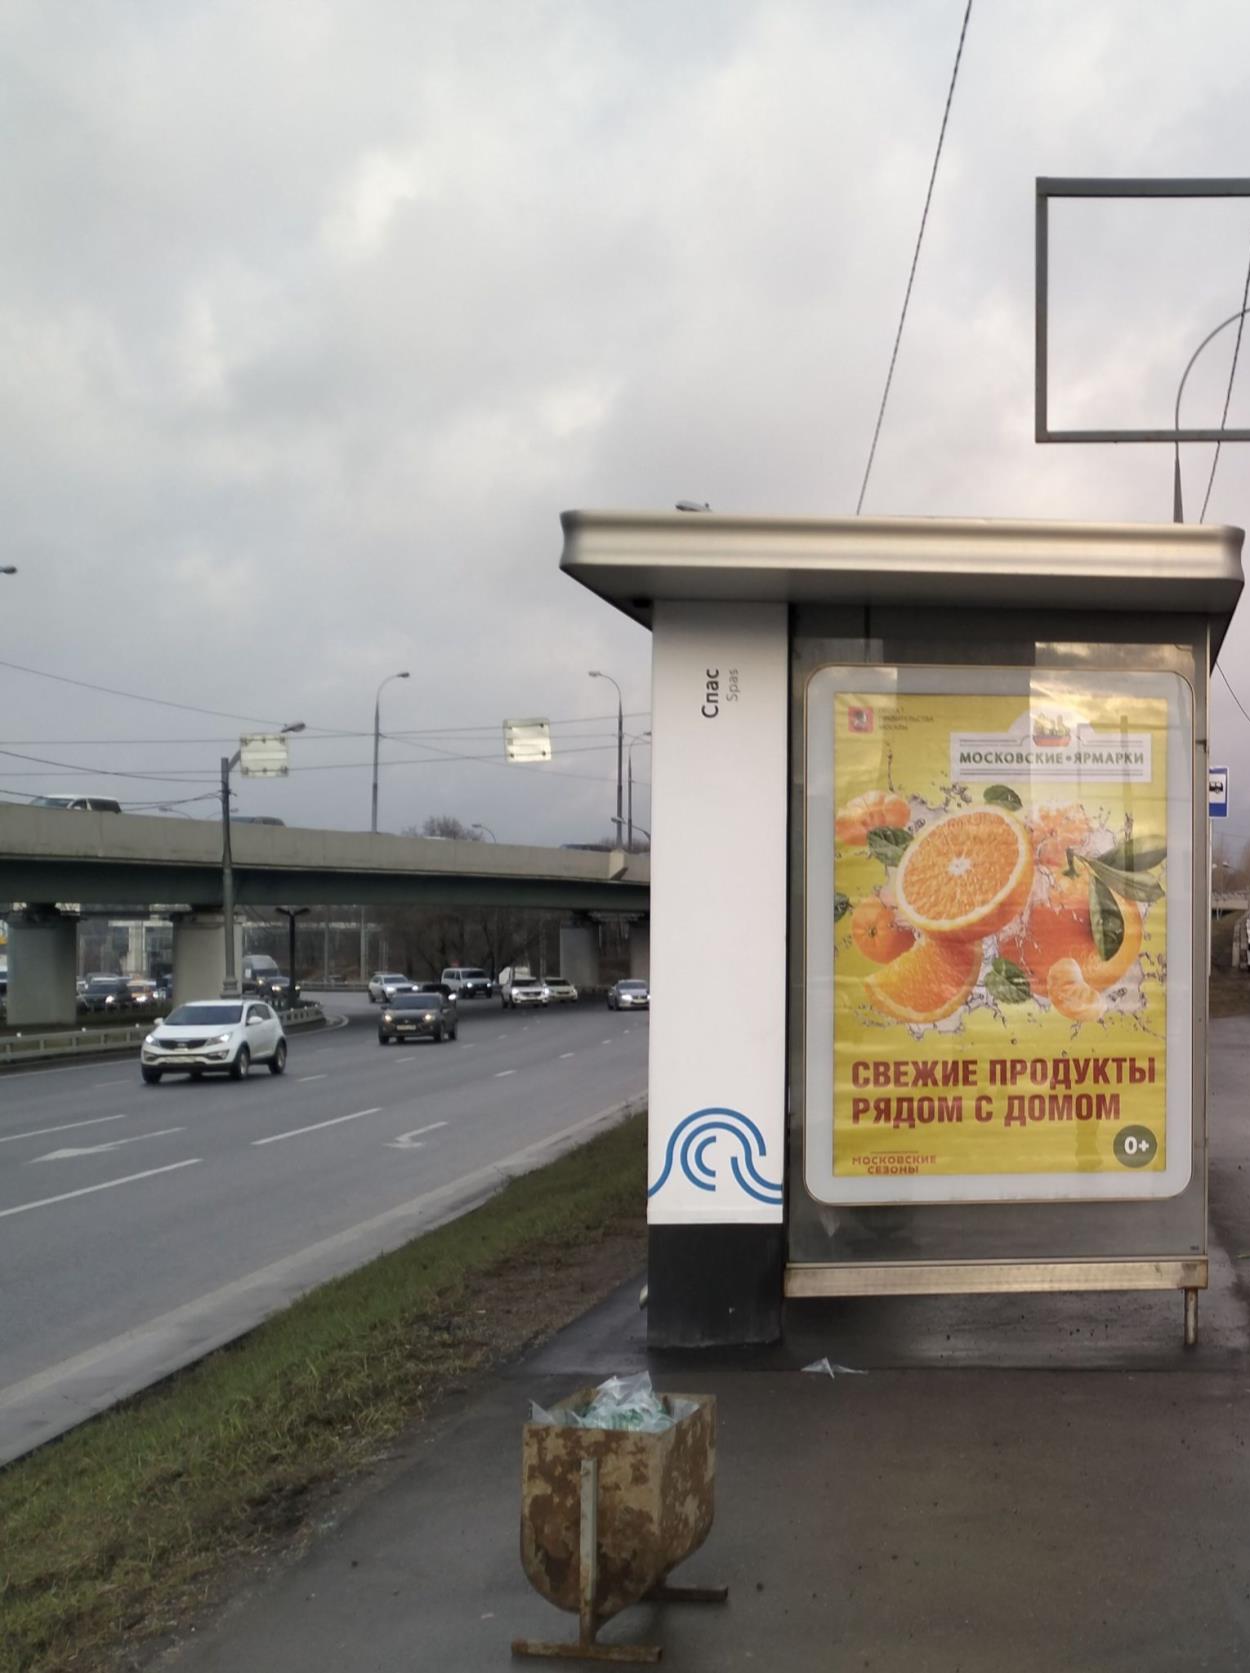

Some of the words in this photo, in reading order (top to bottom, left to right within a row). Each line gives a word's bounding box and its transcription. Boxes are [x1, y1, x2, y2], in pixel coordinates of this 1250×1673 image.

[701, 669, 719, 718] Спас
[726, 669, 741, 702] Spas
[959, 750, 1063, 765] МОСКОВСКИЕ
[1073, 750, 1145, 766] ЯРМАРКИ
[852, 1059, 978, 1089] СВЕЖИЕ
[989, 1057, 1156, 1090] ПРОДУКТЫ
[852, 1095, 963, 1129] РЯДОМ
[974, 1095, 994, 1124] С
[1004, 1093, 1121, 1127] ДОМОМ
[1123, 1136, 1150, 1155] 0+
[852, 1155, 937, 1166] МОСКОВСКИЕ
[867, 1165, 919, 1175] СЕЗОНЫ
